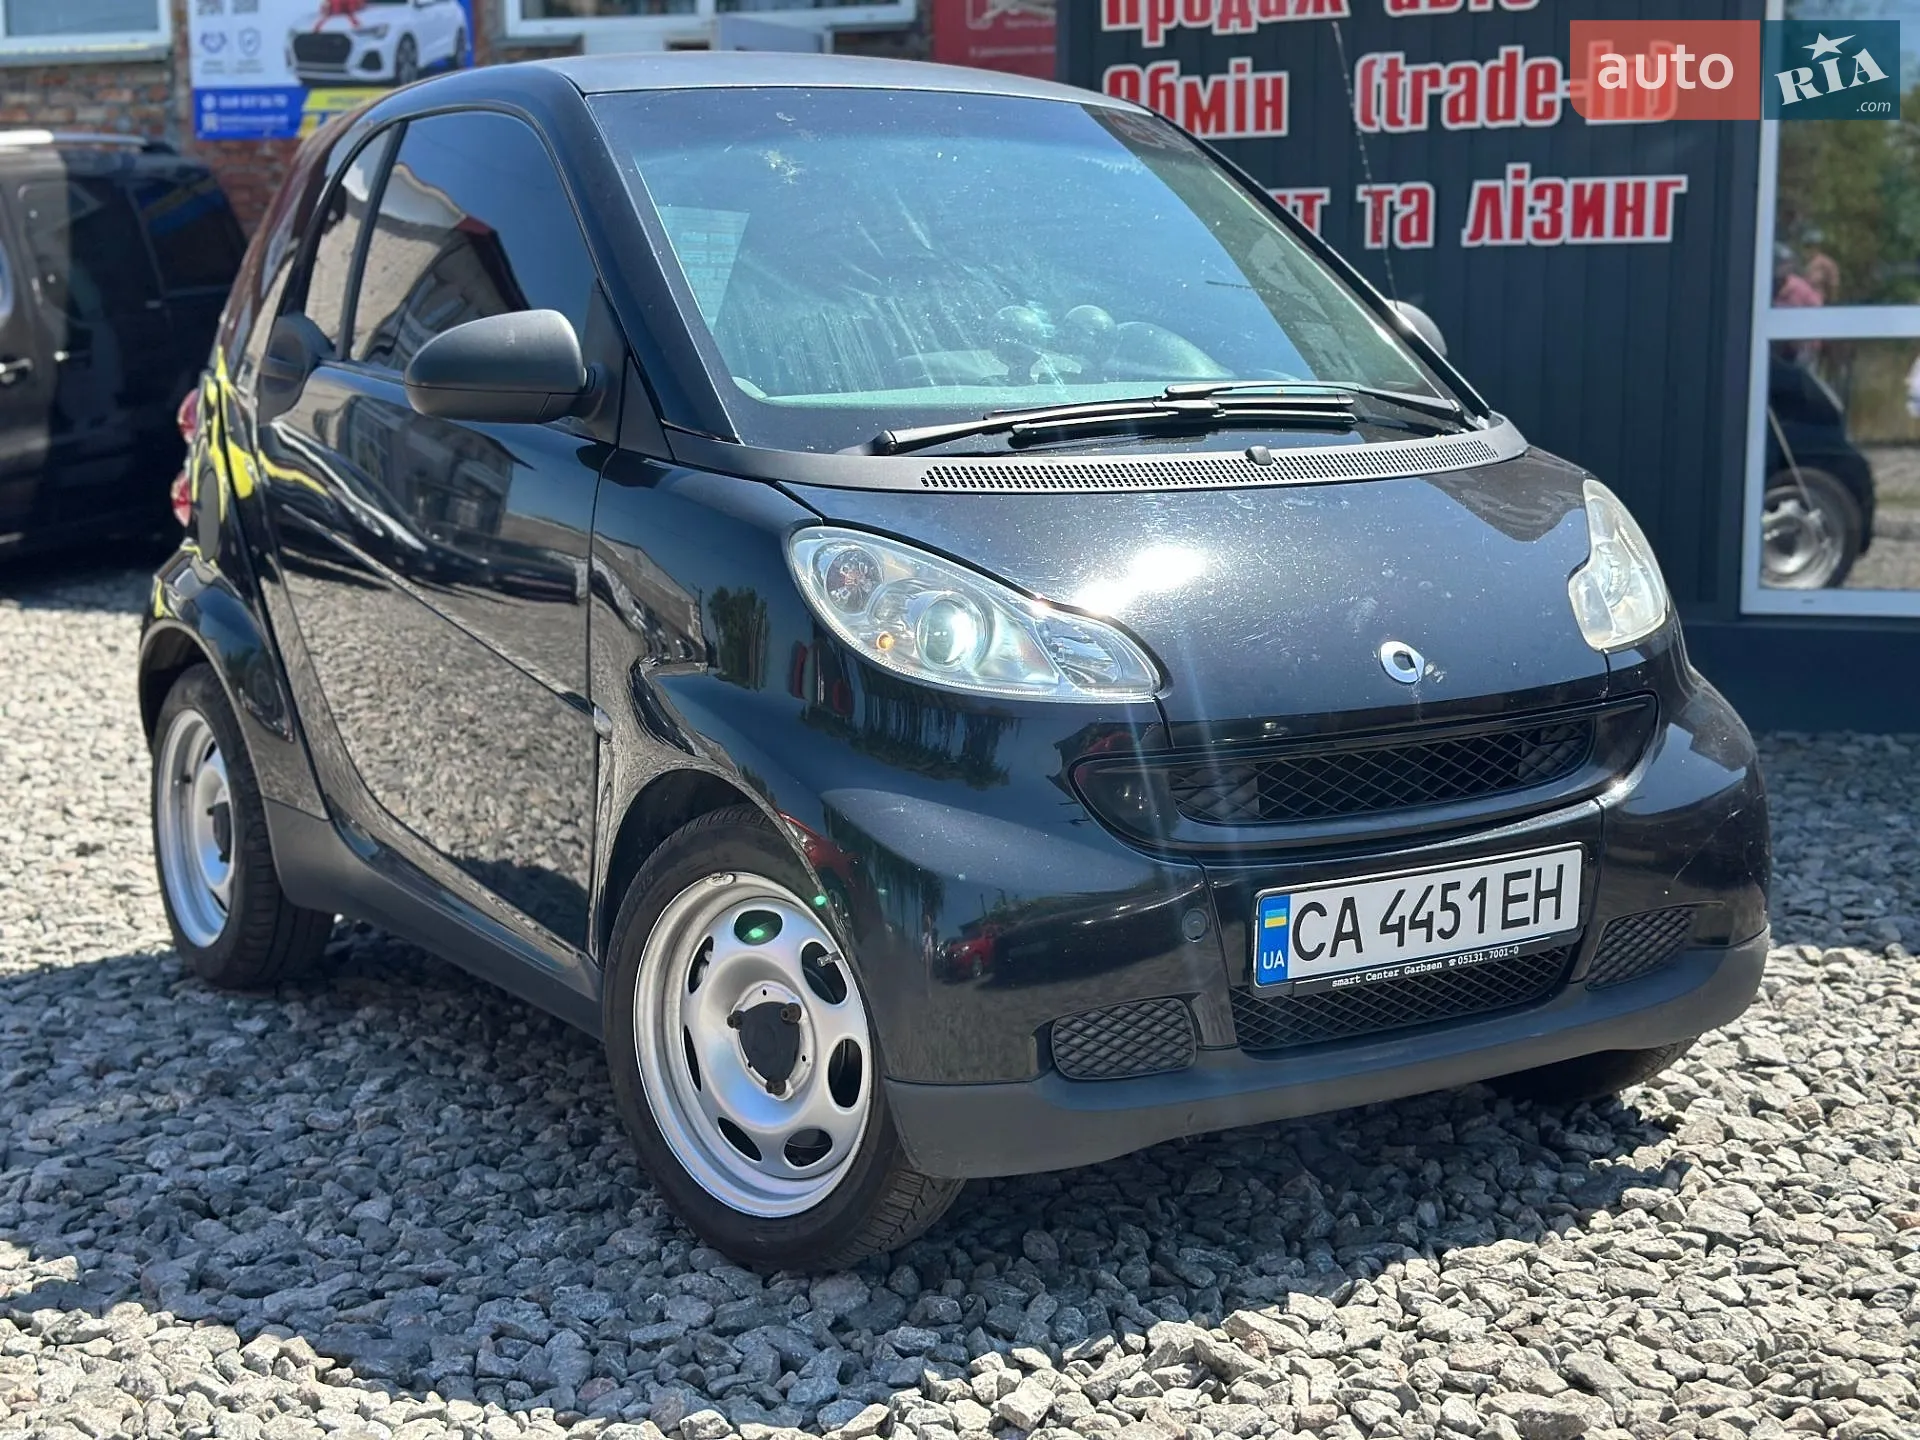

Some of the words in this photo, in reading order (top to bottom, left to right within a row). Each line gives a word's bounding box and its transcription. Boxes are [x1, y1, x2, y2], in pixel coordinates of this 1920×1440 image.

[1357, 180, 1435, 249] та
[1461, 162, 1688, 248] лізинг
[1292, 896, 1364, 962] CA
[1379, 876, 1488, 948] 4451
[1501, 863, 1565, 930] EH
[1262, 950, 1285, 970] UA
[1332, 975, 1361, 988] smart
[1365, 969, 1400, 982] Center
[1404, 961, 1443, 975] Garbsen
